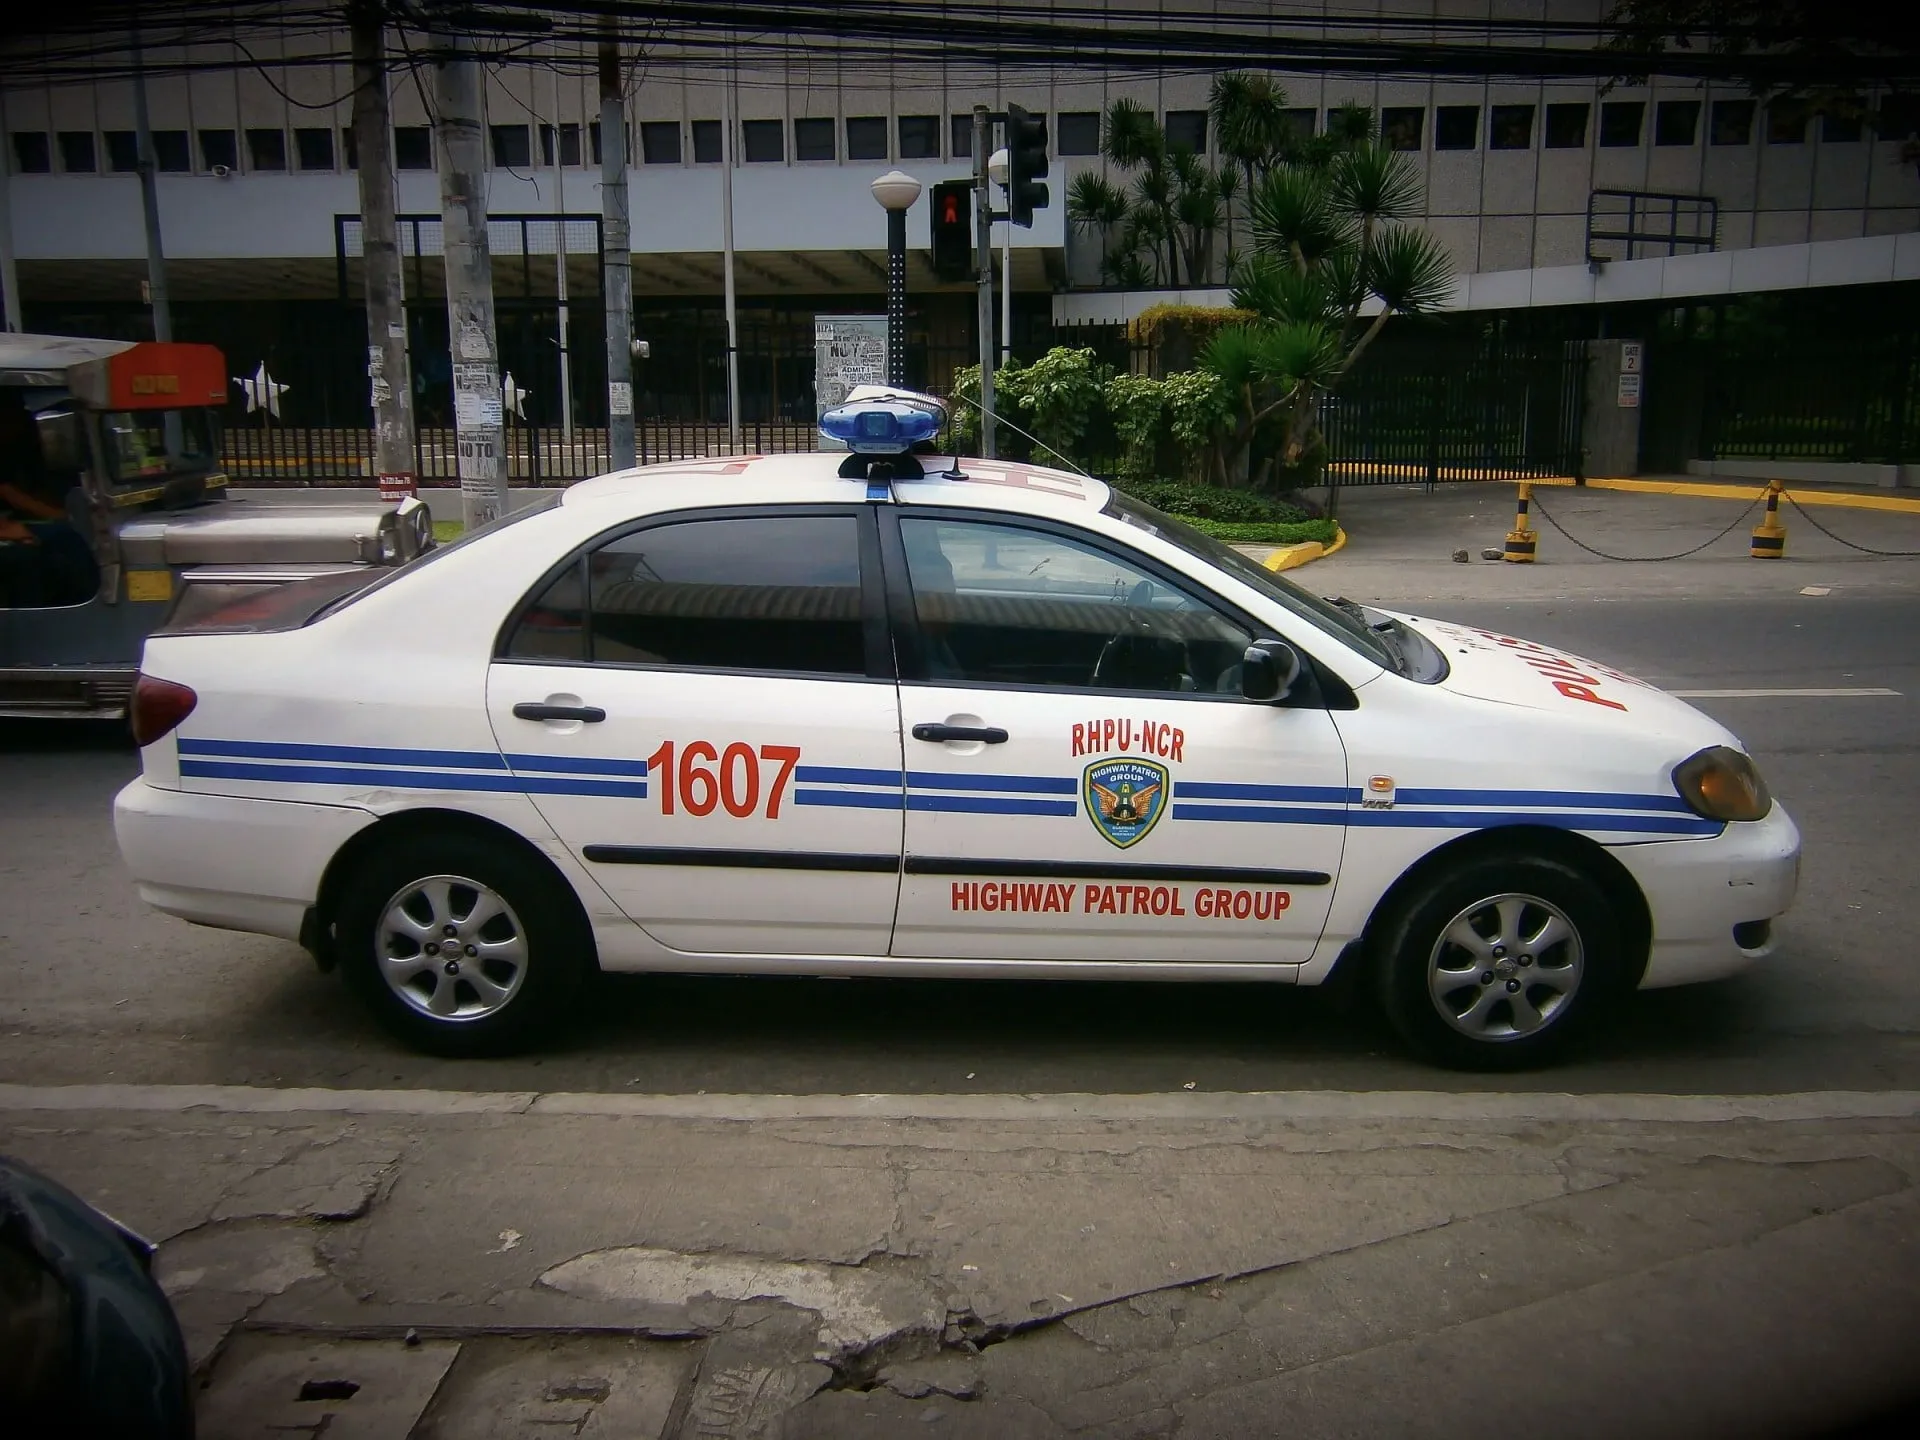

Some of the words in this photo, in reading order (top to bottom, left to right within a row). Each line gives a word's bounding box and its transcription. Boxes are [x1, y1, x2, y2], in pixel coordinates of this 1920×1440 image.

[1628, 358, 1634, 369] 2
[475, 442, 493, 458] TO
[1072, 718, 1184, 763] RHPU-NCR
[647, 740, 801, 819] 1607
[1091, 764, 1130, 780] HIGHWAY
[1131, 765, 1161, 782] PATROL
[1110, 773, 1144, 782] GROUP
[951, 882, 1076, 913] HIGHWAY
[1084, 884, 1185, 916] PATROL
[1194, 887, 1290, 920] GROUP
